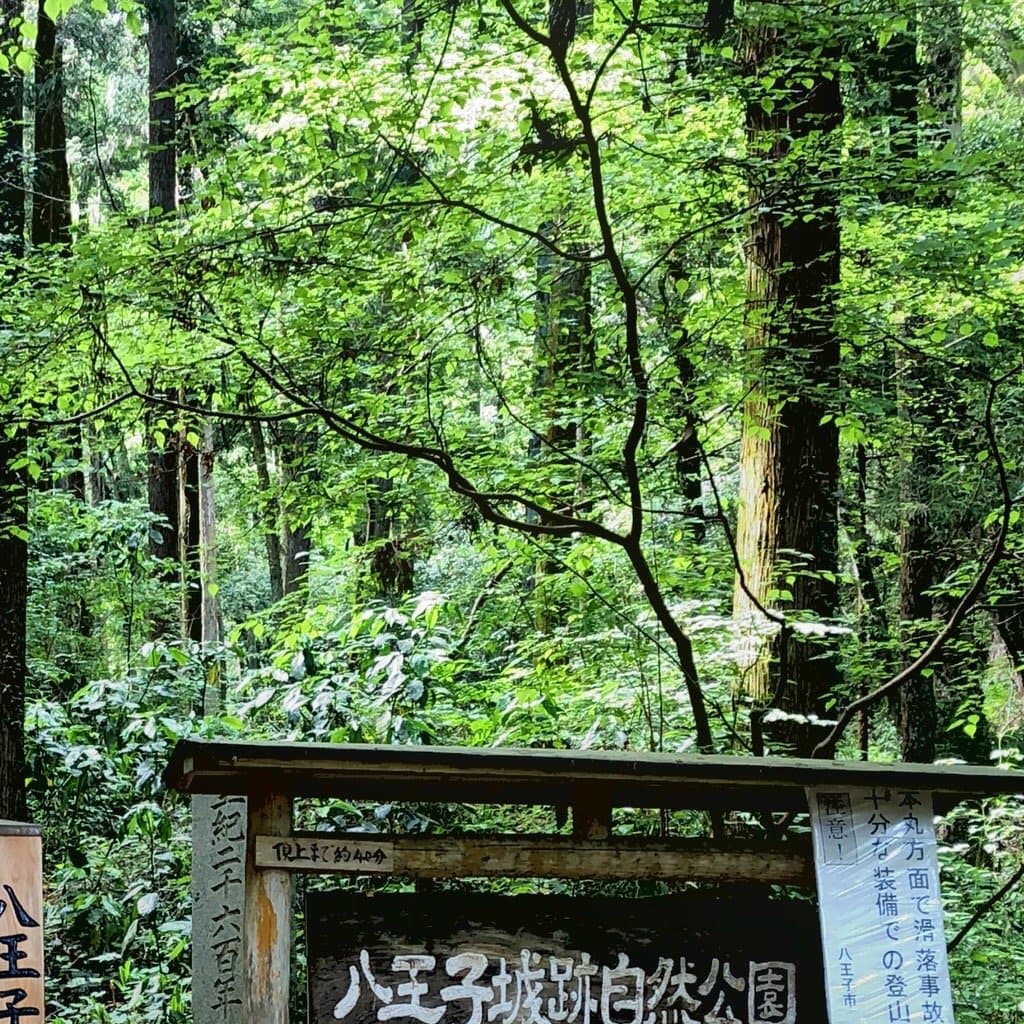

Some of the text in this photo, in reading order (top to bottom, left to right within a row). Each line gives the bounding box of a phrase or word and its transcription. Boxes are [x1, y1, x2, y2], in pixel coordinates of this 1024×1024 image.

[272, 841, 387, 865] 頂上まで約40分
[839, 947, 856, 1007] 八王子市
